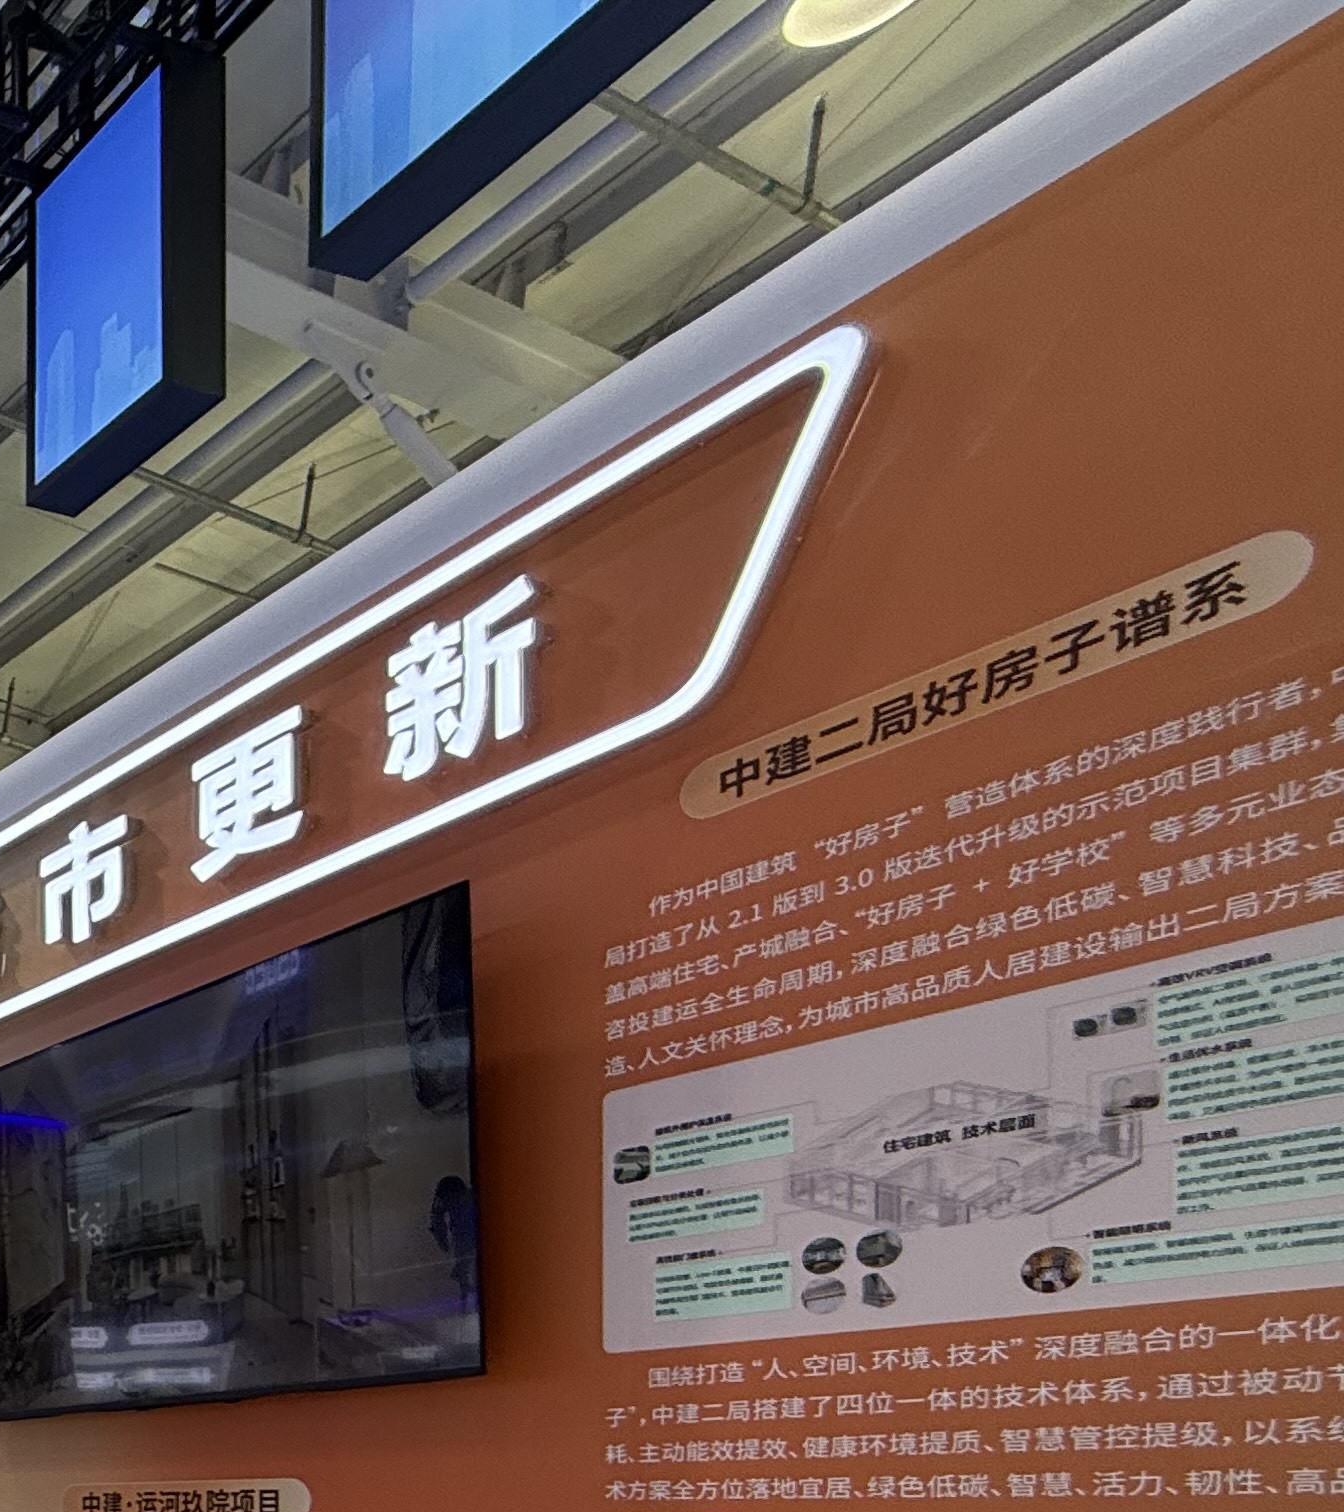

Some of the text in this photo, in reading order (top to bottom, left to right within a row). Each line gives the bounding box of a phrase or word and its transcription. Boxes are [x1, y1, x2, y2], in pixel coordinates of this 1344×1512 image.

[718, 560, 1247, 798] 中建二局好房子谱系
[603, 915, 721, 969] 局打造了从
[727, 903, 764, 929] 2.1
[772, 881, 826, 918] 版到
[834, 867, 875, 897] 3.0
[648, 850, 798, 918] 作为中国建筑
[882, 1129, 952, 1154] 住宅建筑
[648, 1362, 746, 1389] 围绕打造
